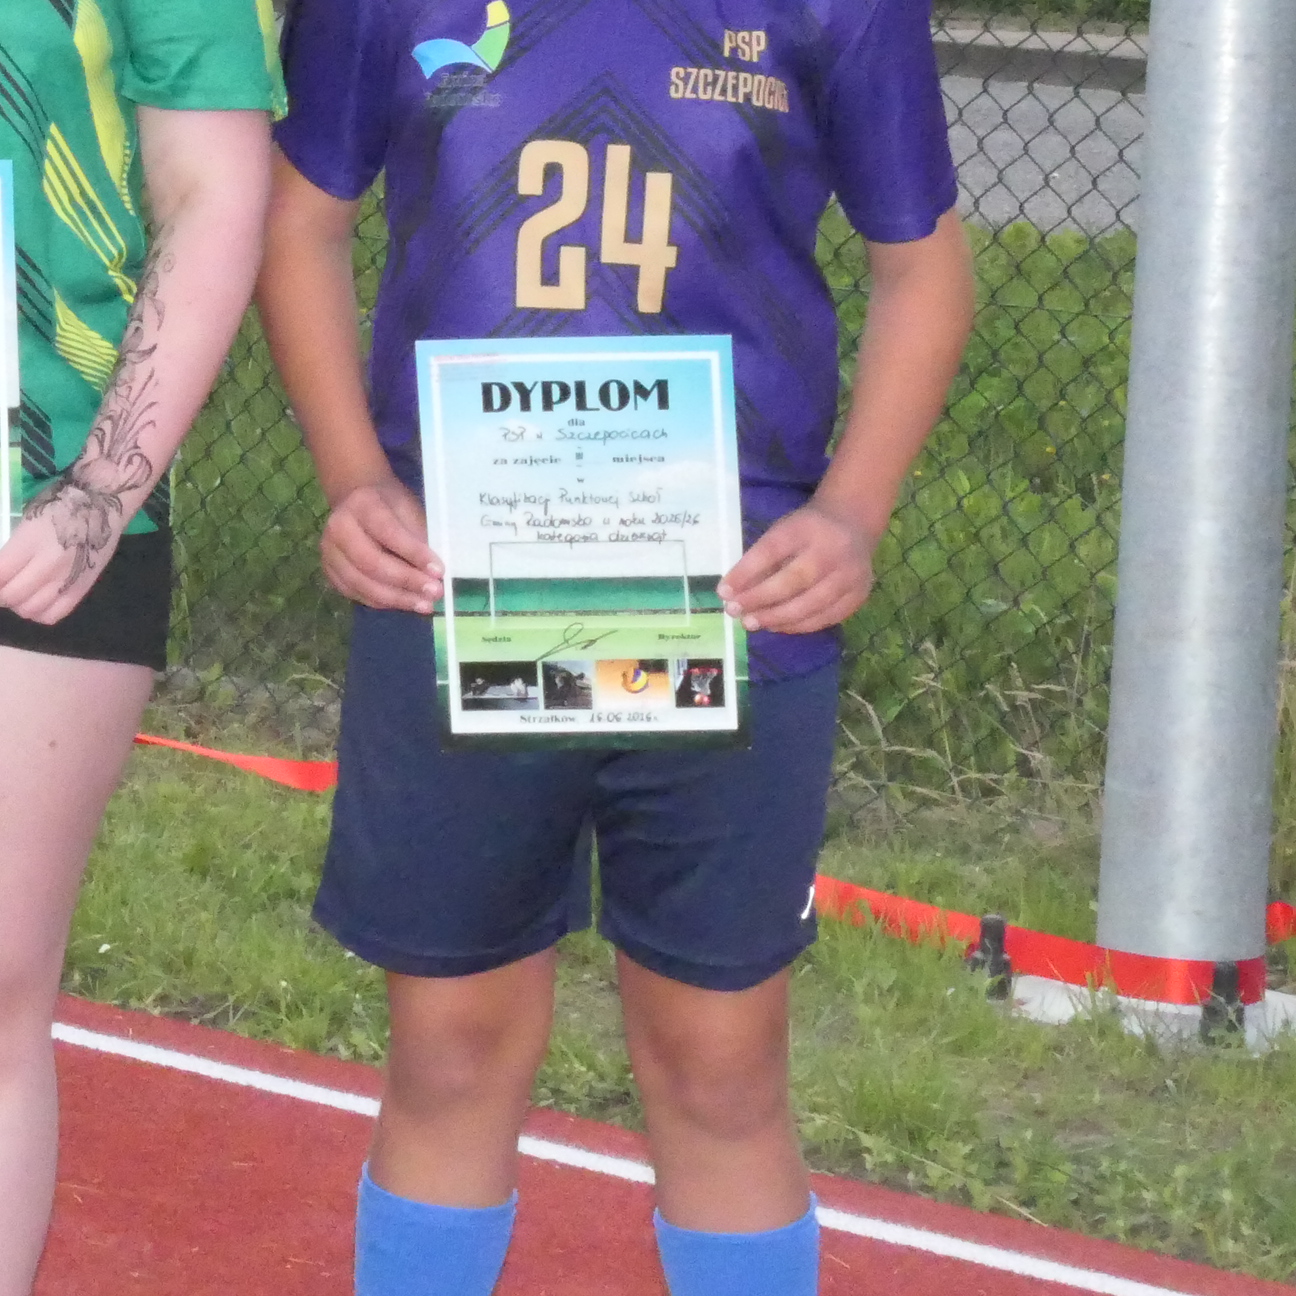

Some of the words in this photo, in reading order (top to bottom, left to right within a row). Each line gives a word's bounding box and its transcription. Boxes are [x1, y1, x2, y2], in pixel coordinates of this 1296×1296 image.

[723, 29, 768, 62] PSP
[515, 139, 678, 314] 24
[480, 378, 670, 413] DYPLOM
[567, 417, 586, 427] dla
[611, 453, 665, 465] miejsca
